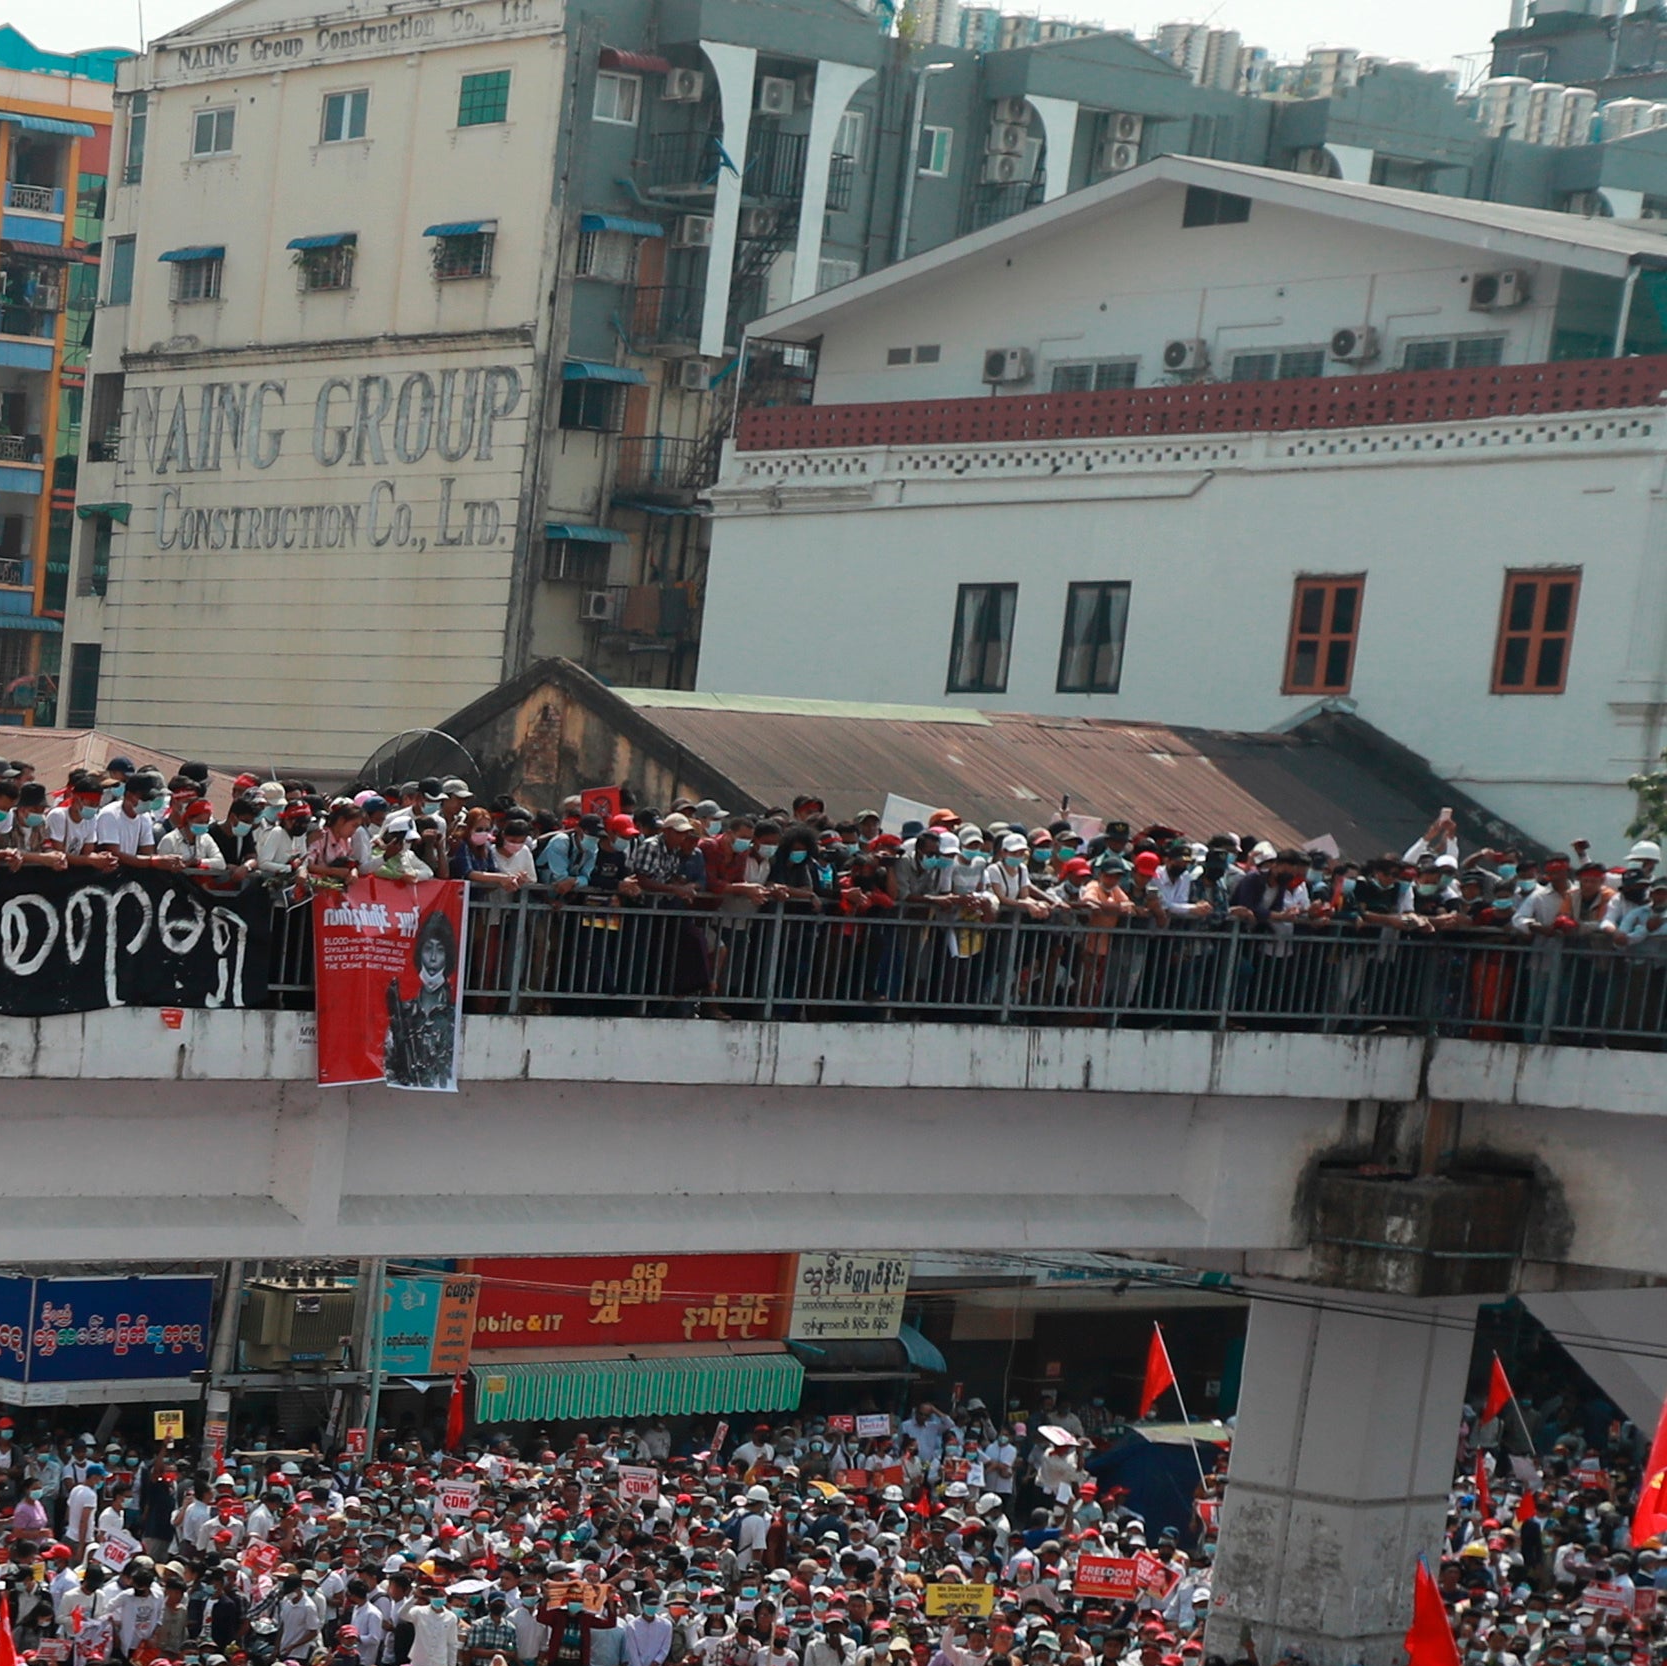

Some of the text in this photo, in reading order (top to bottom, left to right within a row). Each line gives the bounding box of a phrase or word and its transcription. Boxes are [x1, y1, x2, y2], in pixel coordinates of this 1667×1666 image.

[176, 43, 239, 72] NAING
[250, 39, 304, 60] Group
[316, 16, 435, 51] Construction
[499, 3, 539, 27] Ltd.
[125, 365, 523, 475] NAING GROUP
[543, 1314, 564, 1332] IT
[626, 1480, 650, 1494] CDM
[443, 1494, 471, 1510] CDM
[104, 1544, 127, 1565] CDM
[1079, 1575, 1132, 1587] OVER FEAR
[1081, 1566, 1135, 1579] FREEDOM
